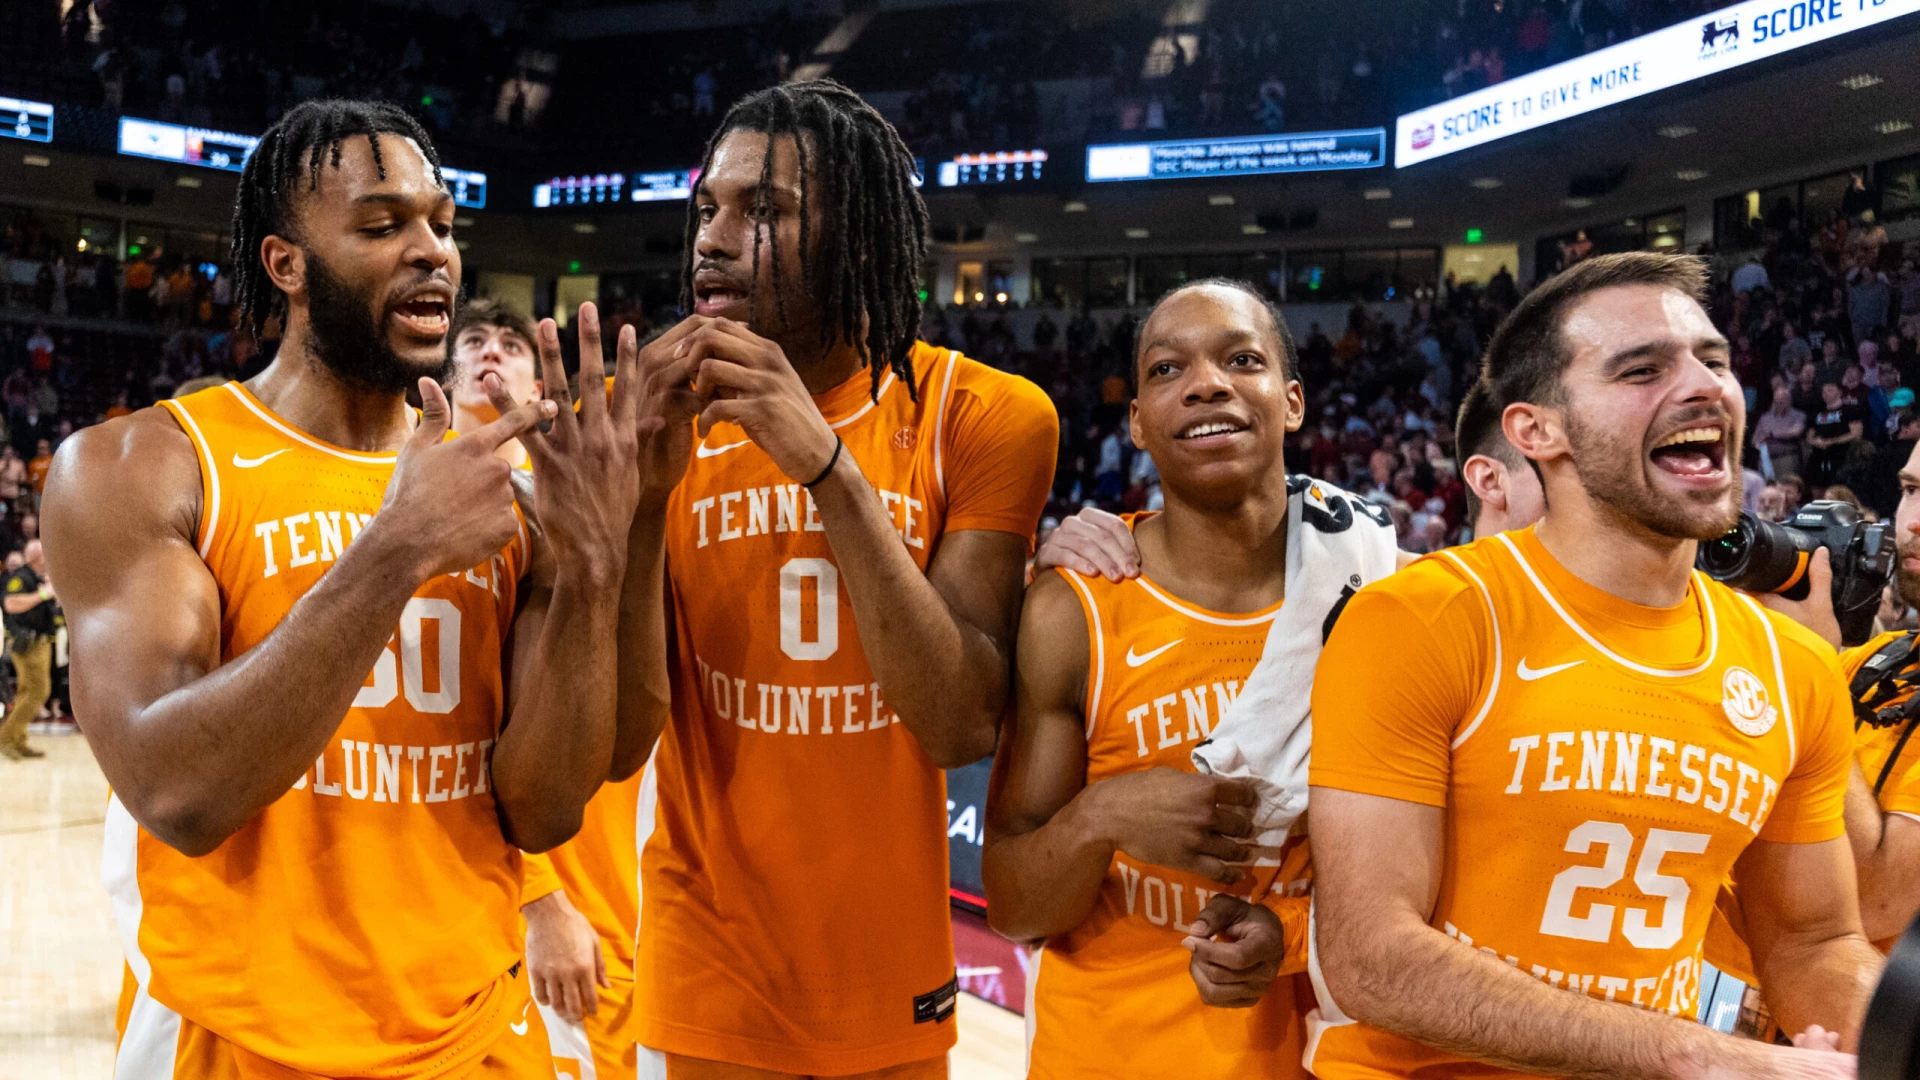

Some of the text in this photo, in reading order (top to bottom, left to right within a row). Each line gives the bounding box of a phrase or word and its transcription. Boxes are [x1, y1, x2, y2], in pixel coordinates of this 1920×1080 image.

[1443, 61, 1643, 140] SCORE TO GIVE MORE
[1222, 158, 1238, 170] of
[1239, 156, 1260, 168] the
[1297, 153, 1317, 165] on
[1318, 149, 1372, 164] Monday
[1262, 142, 1289, 154] was
[1289, 138, 1337, 152] named
[894, 428, 916, 449] SEC
[780, 558, 838, 660] 0
[1726, 670, 1765, 717] SEC
[1505, 731, 1777, 835] TENNESSEE
[1539, 820, 1712, 949] 25
